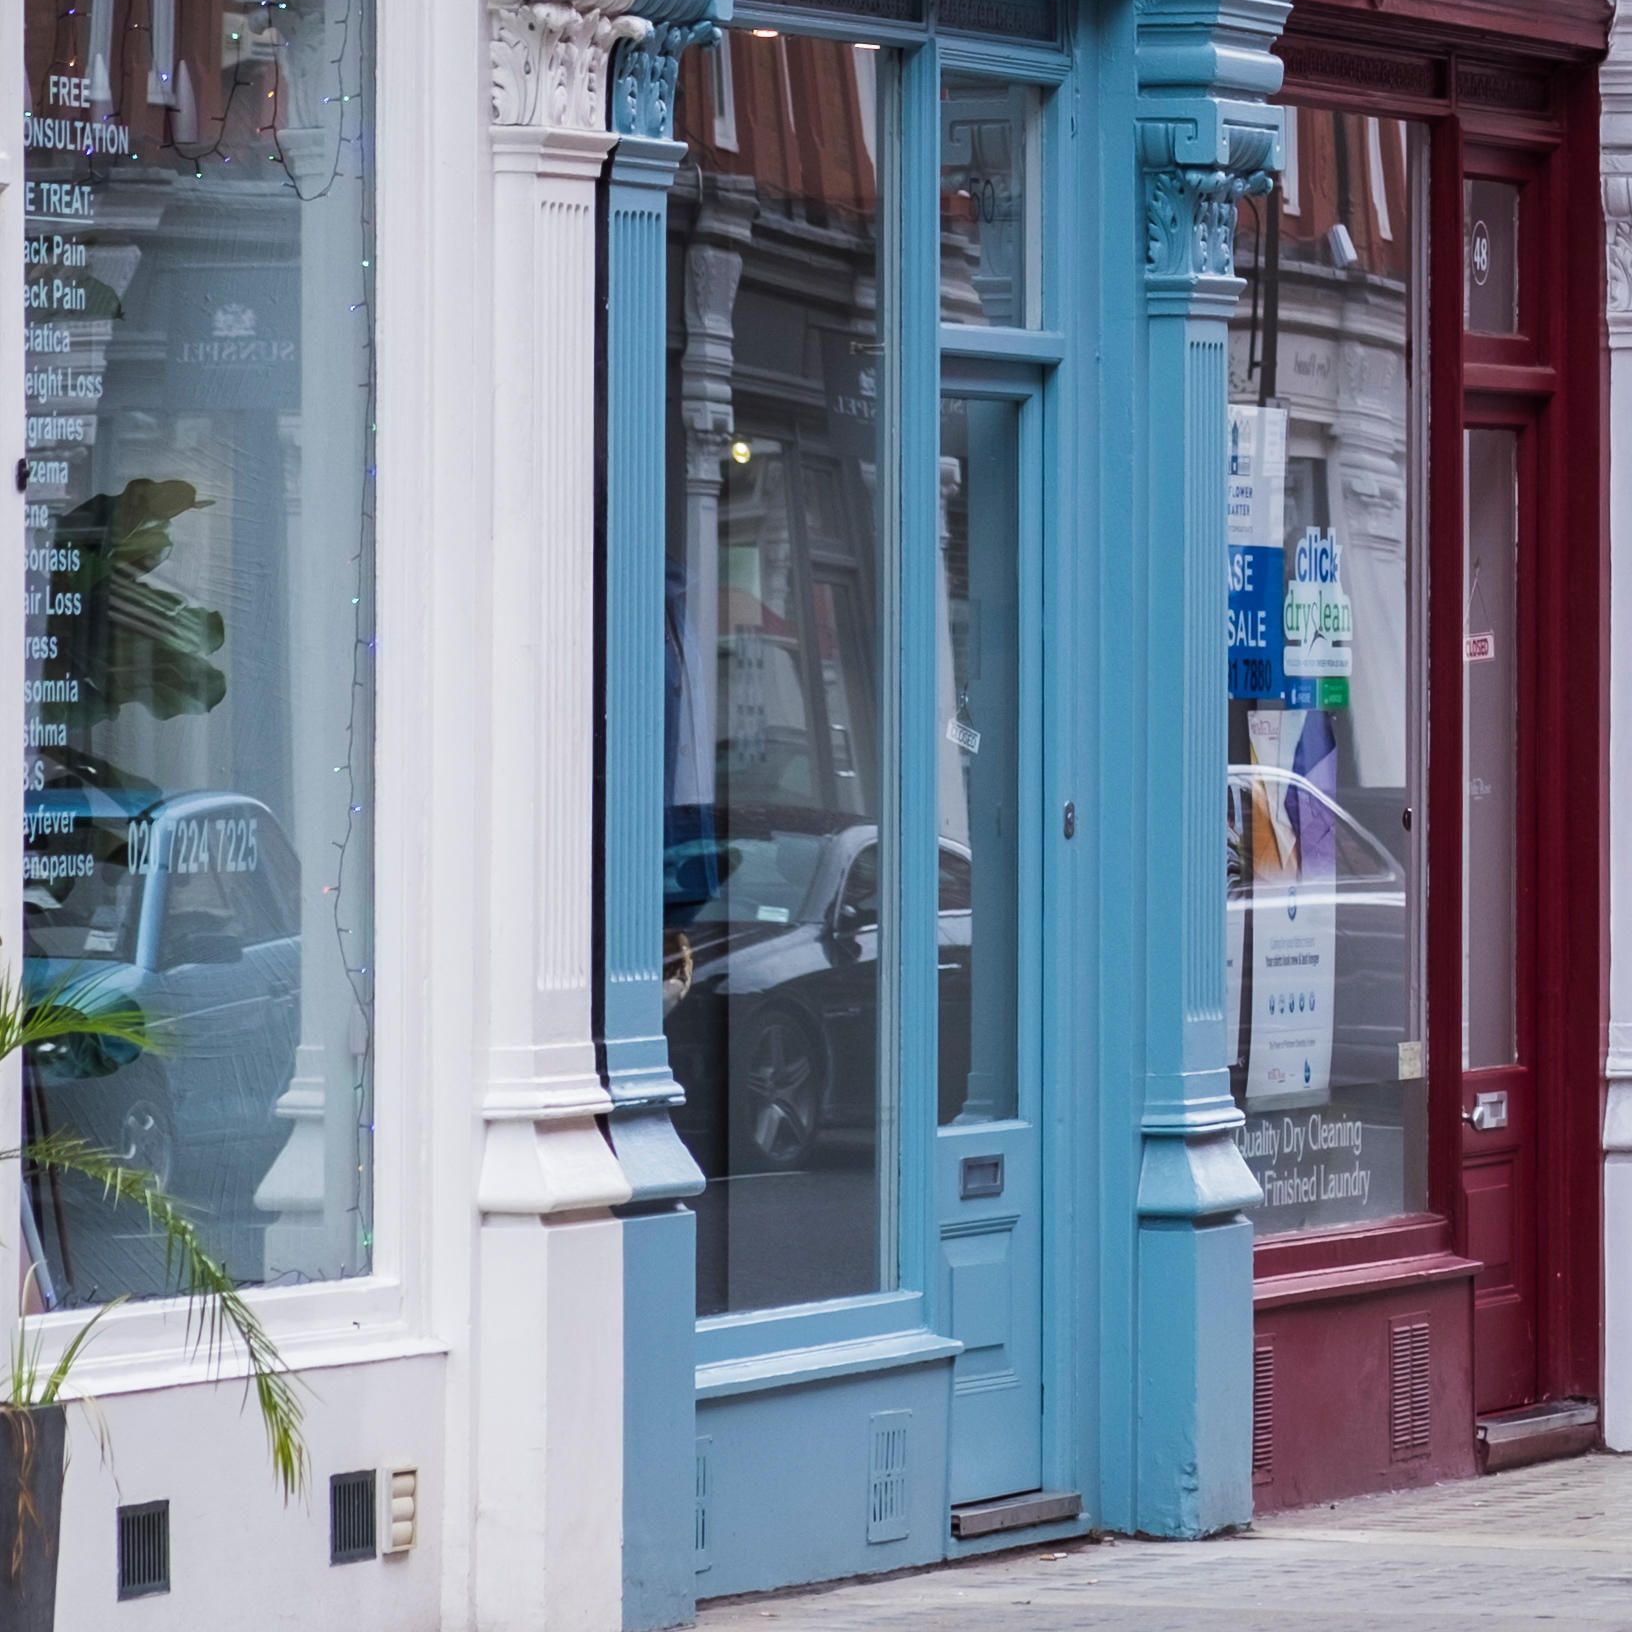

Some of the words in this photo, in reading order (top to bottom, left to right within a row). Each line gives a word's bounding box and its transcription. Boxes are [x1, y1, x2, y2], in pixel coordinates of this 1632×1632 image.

[49, 75, 91, 109] FREE
[40, 183, 95, 216] TREAT:
[53, 234, 86, 267] Pain
[1473, 236, 1488, 272] 48
[53, 278, 86, 311] Pain
[67, 367, 104, 399] Loss
[1296, 531, 1341, 583] click
[45, 585, 82, 616] Loss
[1242, 658, 1272, 693] 7880
[128, 820, 160, 875] 020
[167, 819, 210, 874] 7224
[216, 818, 258, 873] 7225
[1235, 1118, 1280, 1165] Quality
[1283, 1116, 1306, 1162] Dry
[1308, 1113, 1362, 1155] Cleaning
[1263, 1165, 1317, 1207] Finished
[1320, 1159, 1371, 1206] Laundry
